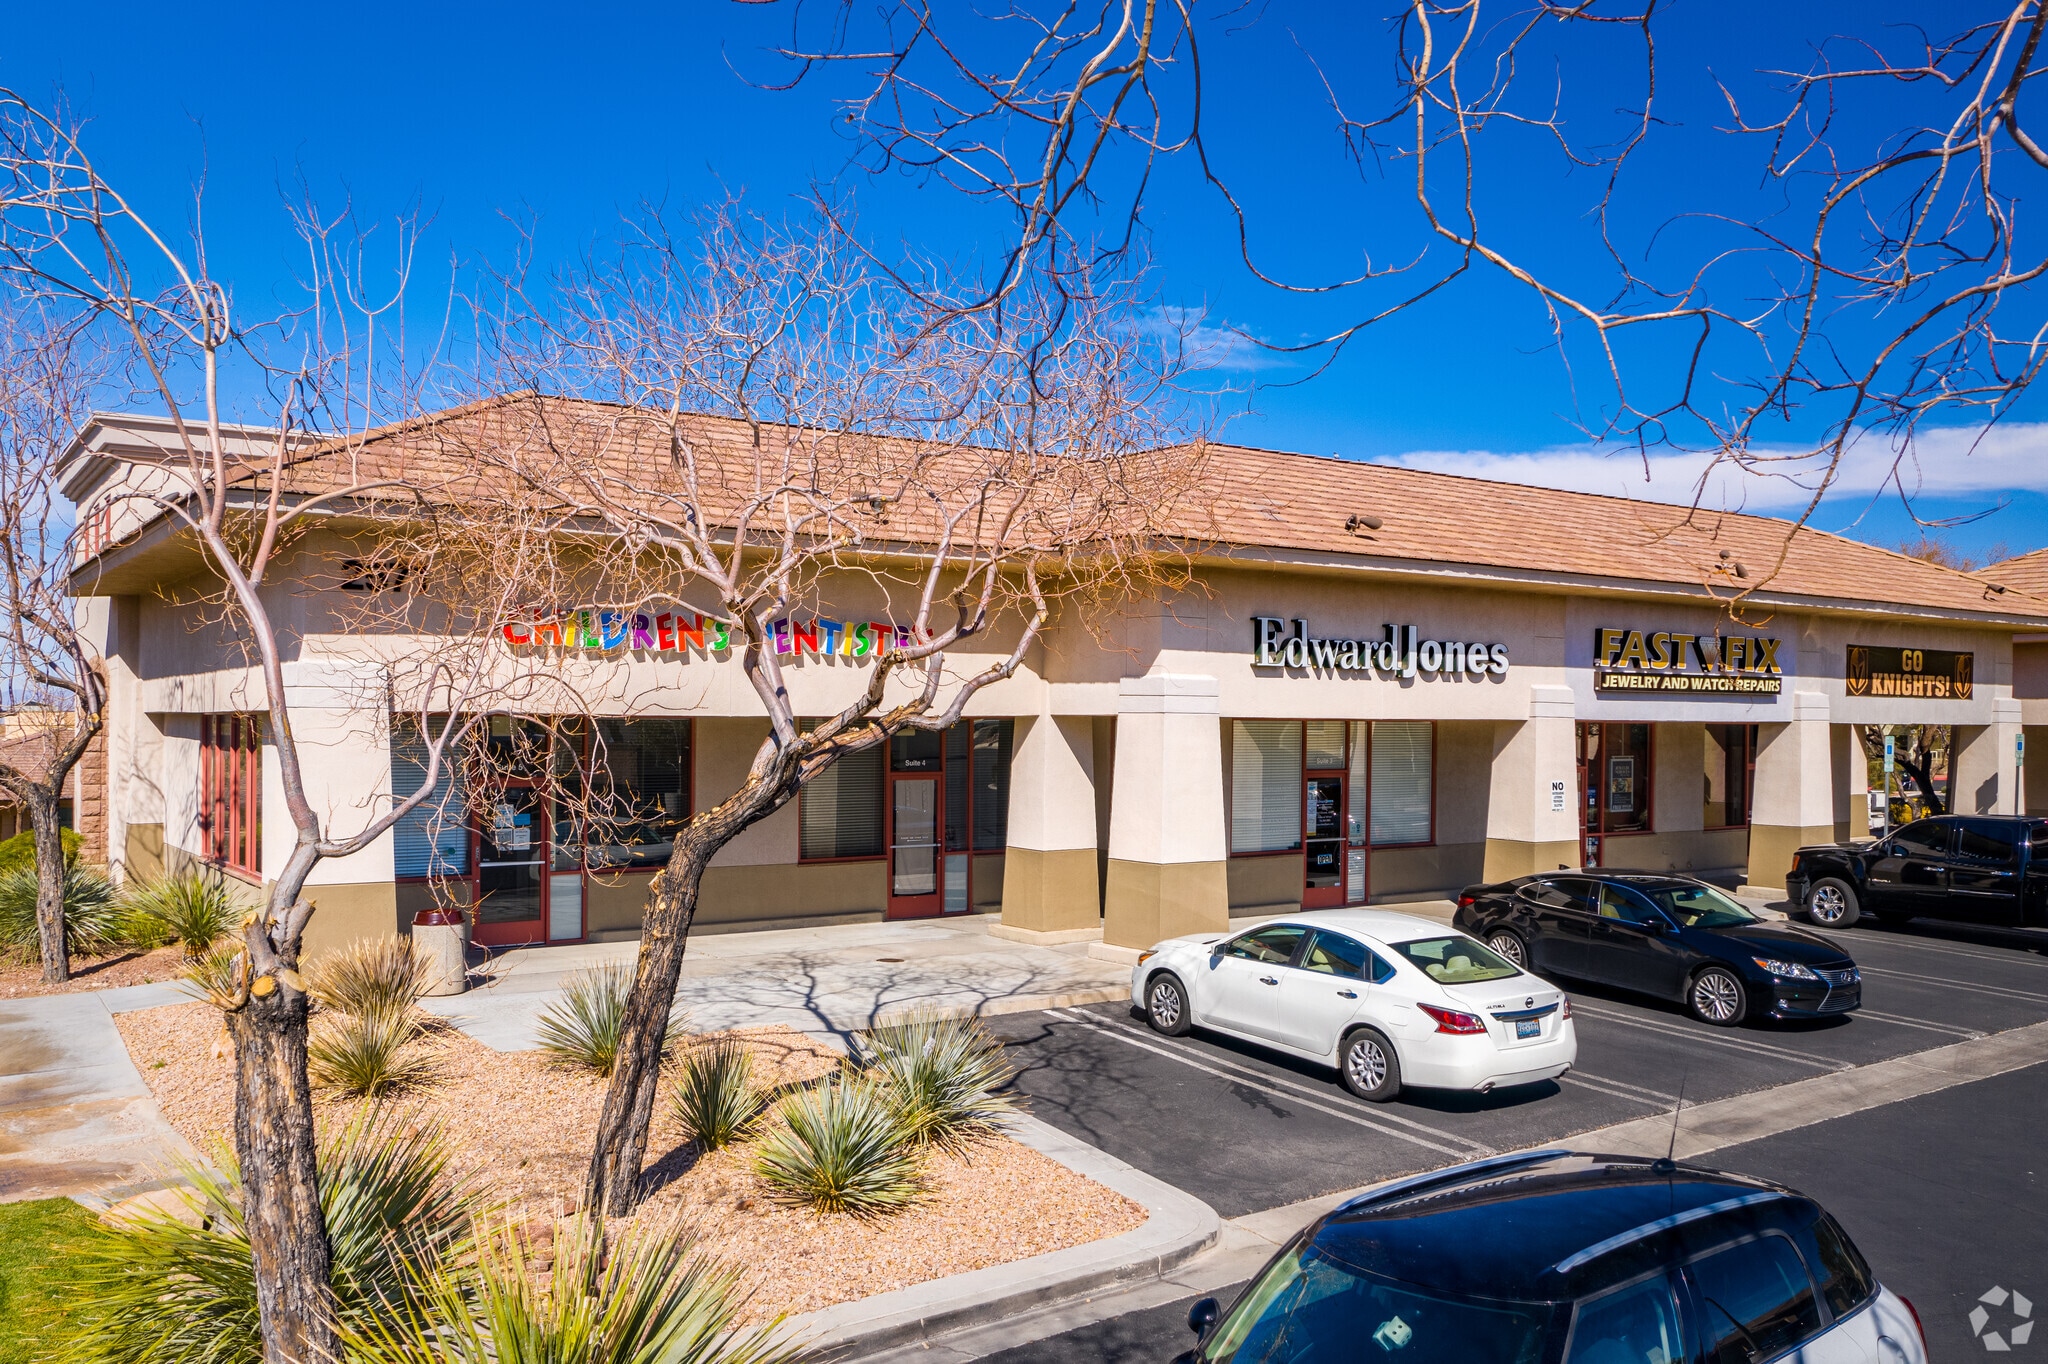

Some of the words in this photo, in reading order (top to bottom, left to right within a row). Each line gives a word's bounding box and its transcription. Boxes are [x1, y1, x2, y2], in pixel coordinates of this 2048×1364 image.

[501, 607, 731, 653] CHILDREN'S
[759, 617, 934, 658] ENTISTR
[1598, 628, 1695, 669] FAST
[1725, 636, 1784, 673] FIX
[1902, 650, 1923, 672] GO
[1602, 674, 1661, 689] JEWELRY
[1661, 676, 1689, 690] AND
[1691, 677, 1736, 691] WATCH
[1735, 678, 1781, 692] REPAIRS
[1871, 673, 1950, 697] KNIGHTS!
[905, 759, 921, 767] Suite
[1552, 782, 1564, 791] NO
[1319, 855, 1331, 864] OPEN
